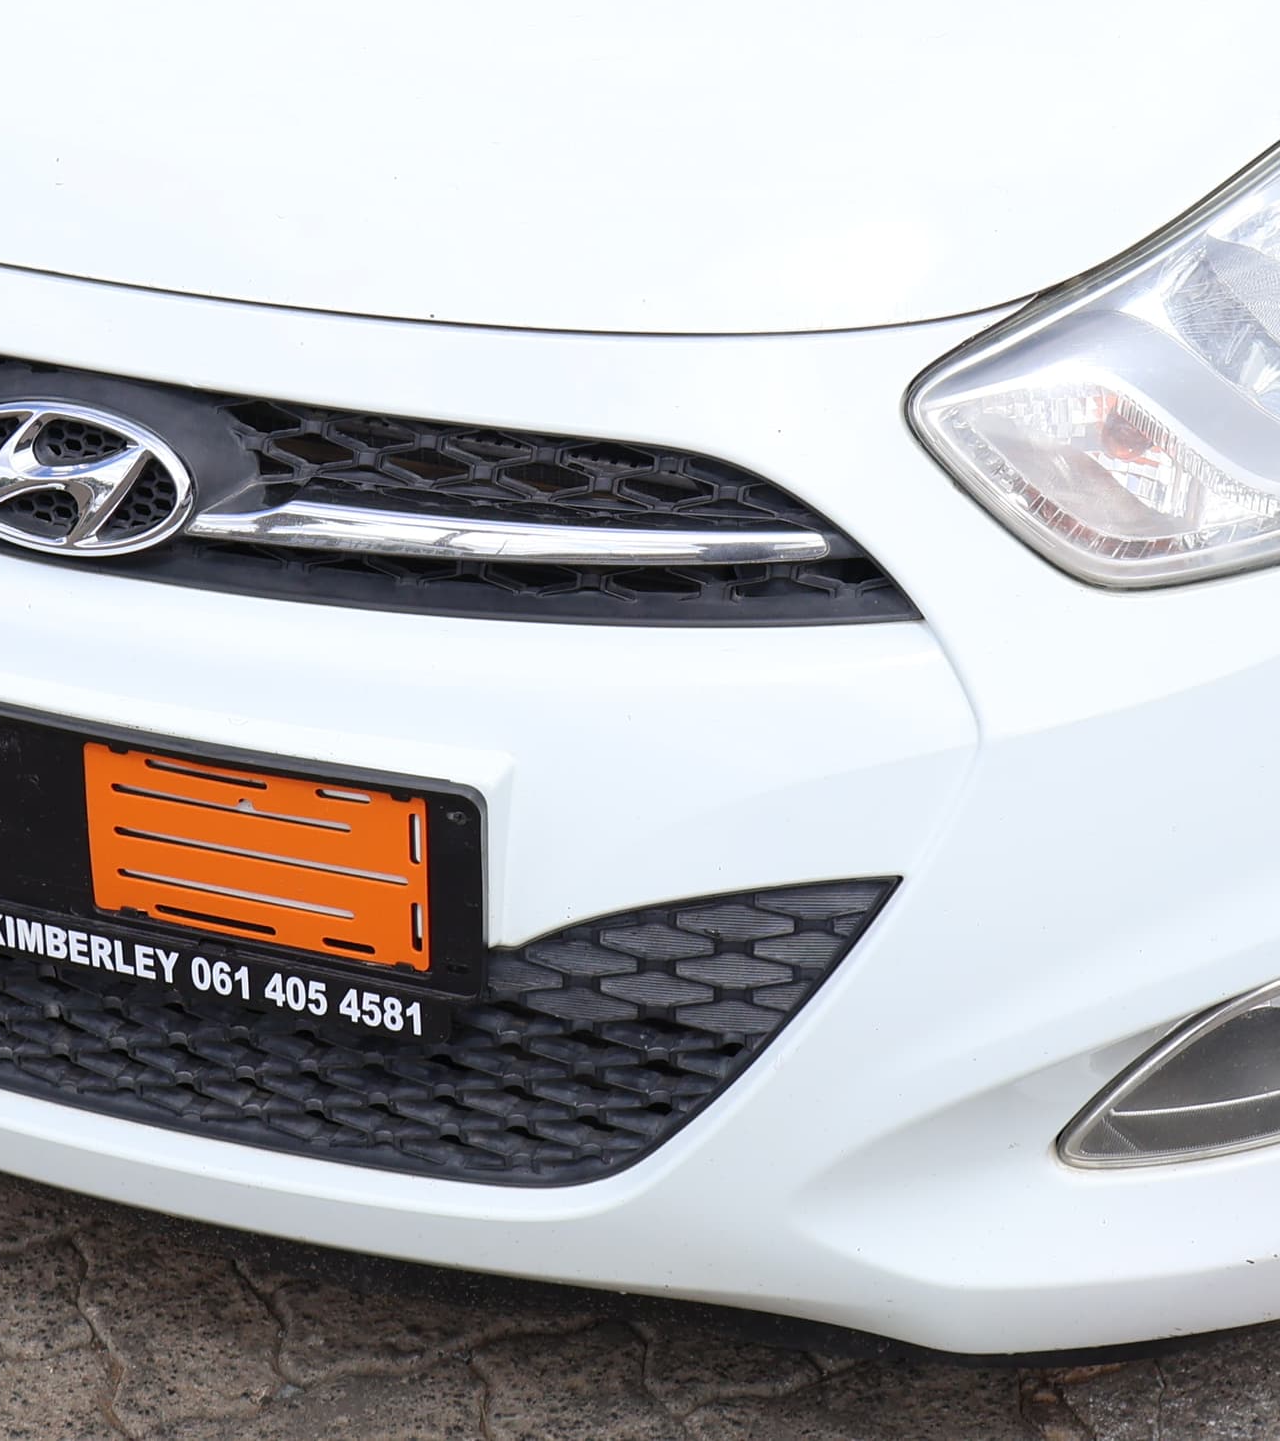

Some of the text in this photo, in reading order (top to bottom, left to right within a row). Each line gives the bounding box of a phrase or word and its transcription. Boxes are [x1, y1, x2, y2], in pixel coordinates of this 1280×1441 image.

[191, 956, 251, 1000] 061
[264, 972, 328, 1016] 405
[339, 988, 423, 1036] 4581
